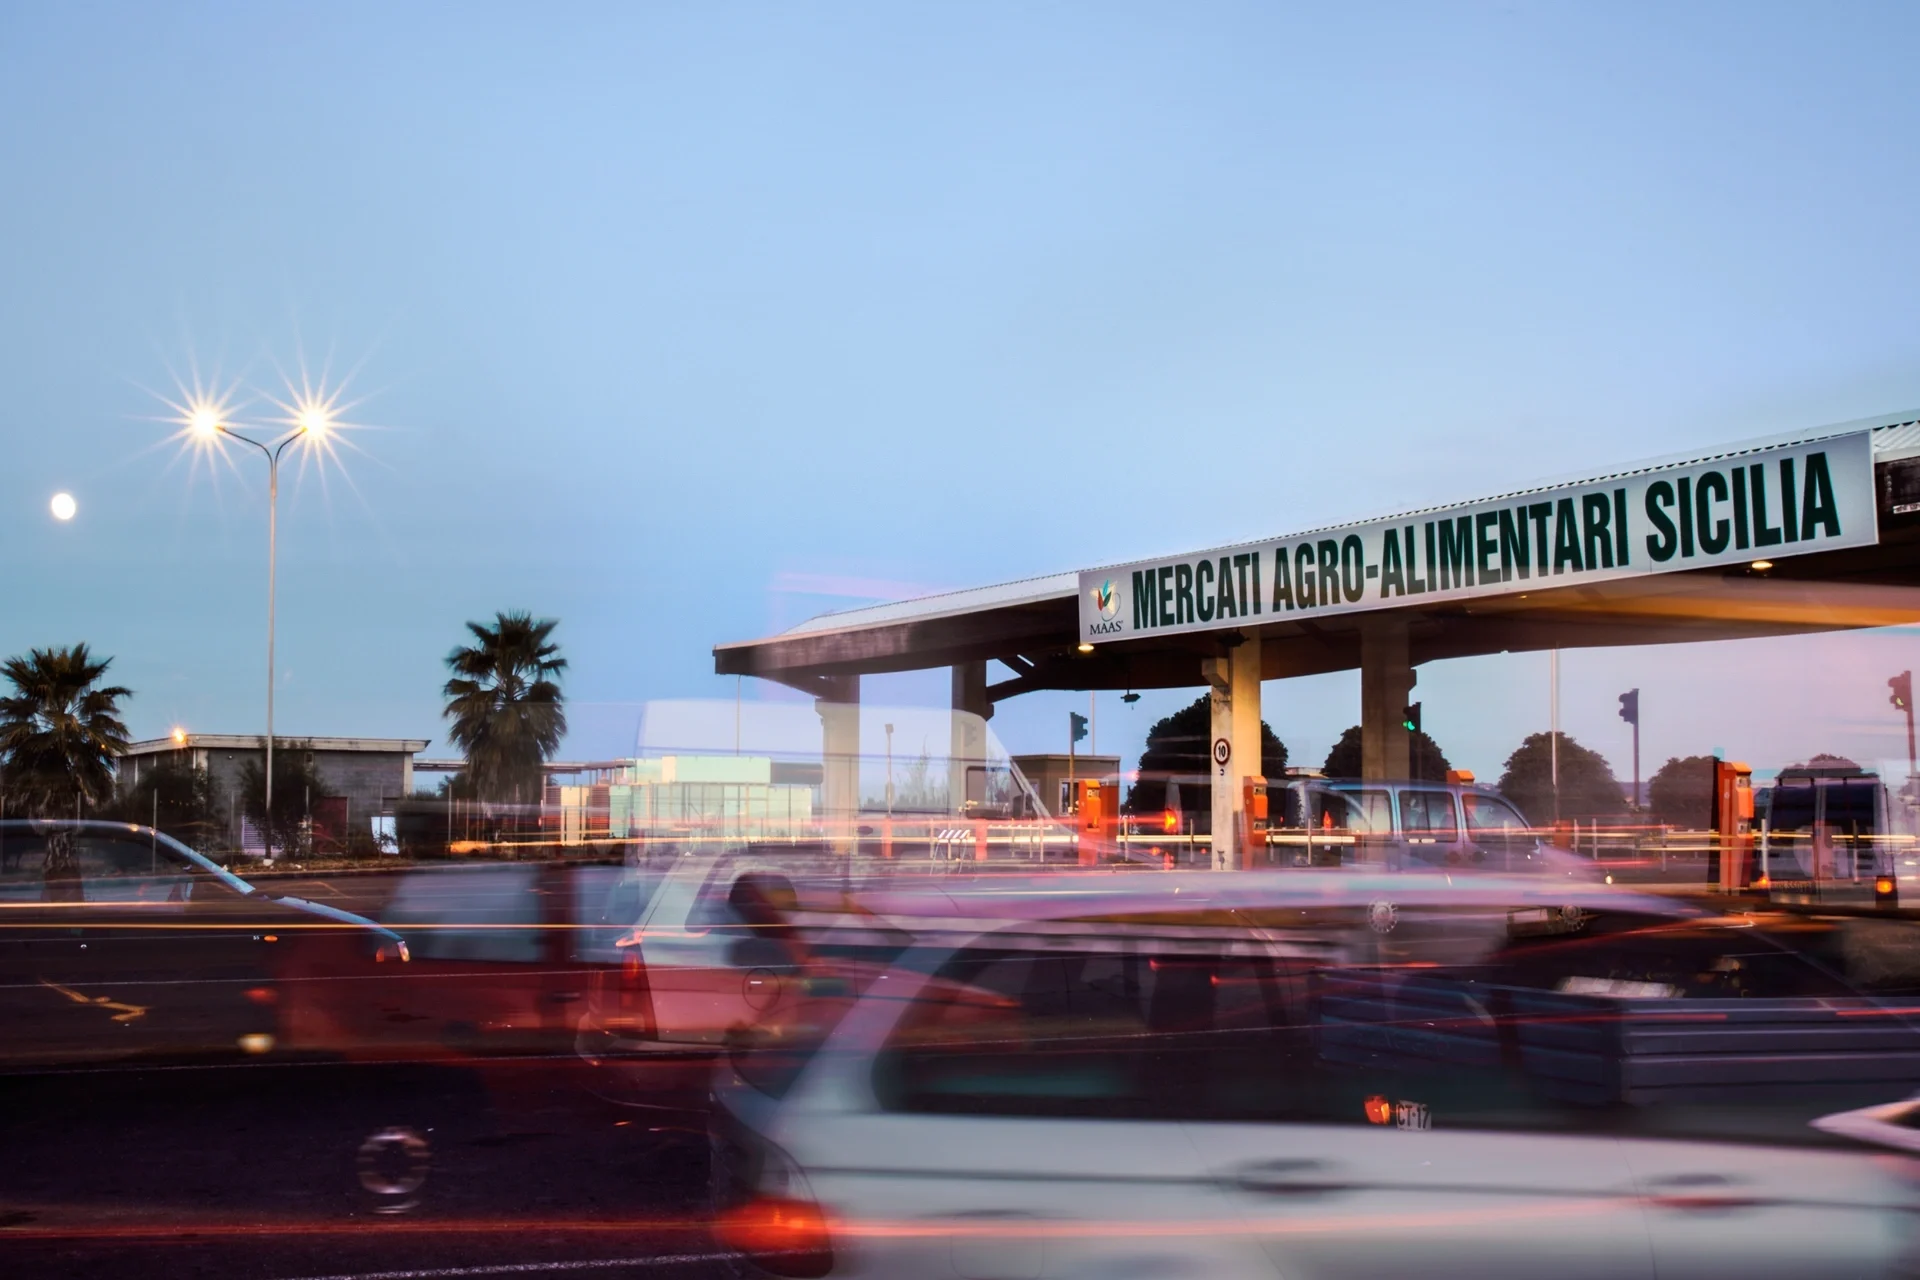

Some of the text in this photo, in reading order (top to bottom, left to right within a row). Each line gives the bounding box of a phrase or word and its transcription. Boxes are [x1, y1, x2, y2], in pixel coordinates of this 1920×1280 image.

[1132, 451, 1842, 630] MERCATI AGRO-ALIMENTARI SICILIA
[1089, 621, 1122, 635] MAAS
[1218, 745, 1226, 758] 10
